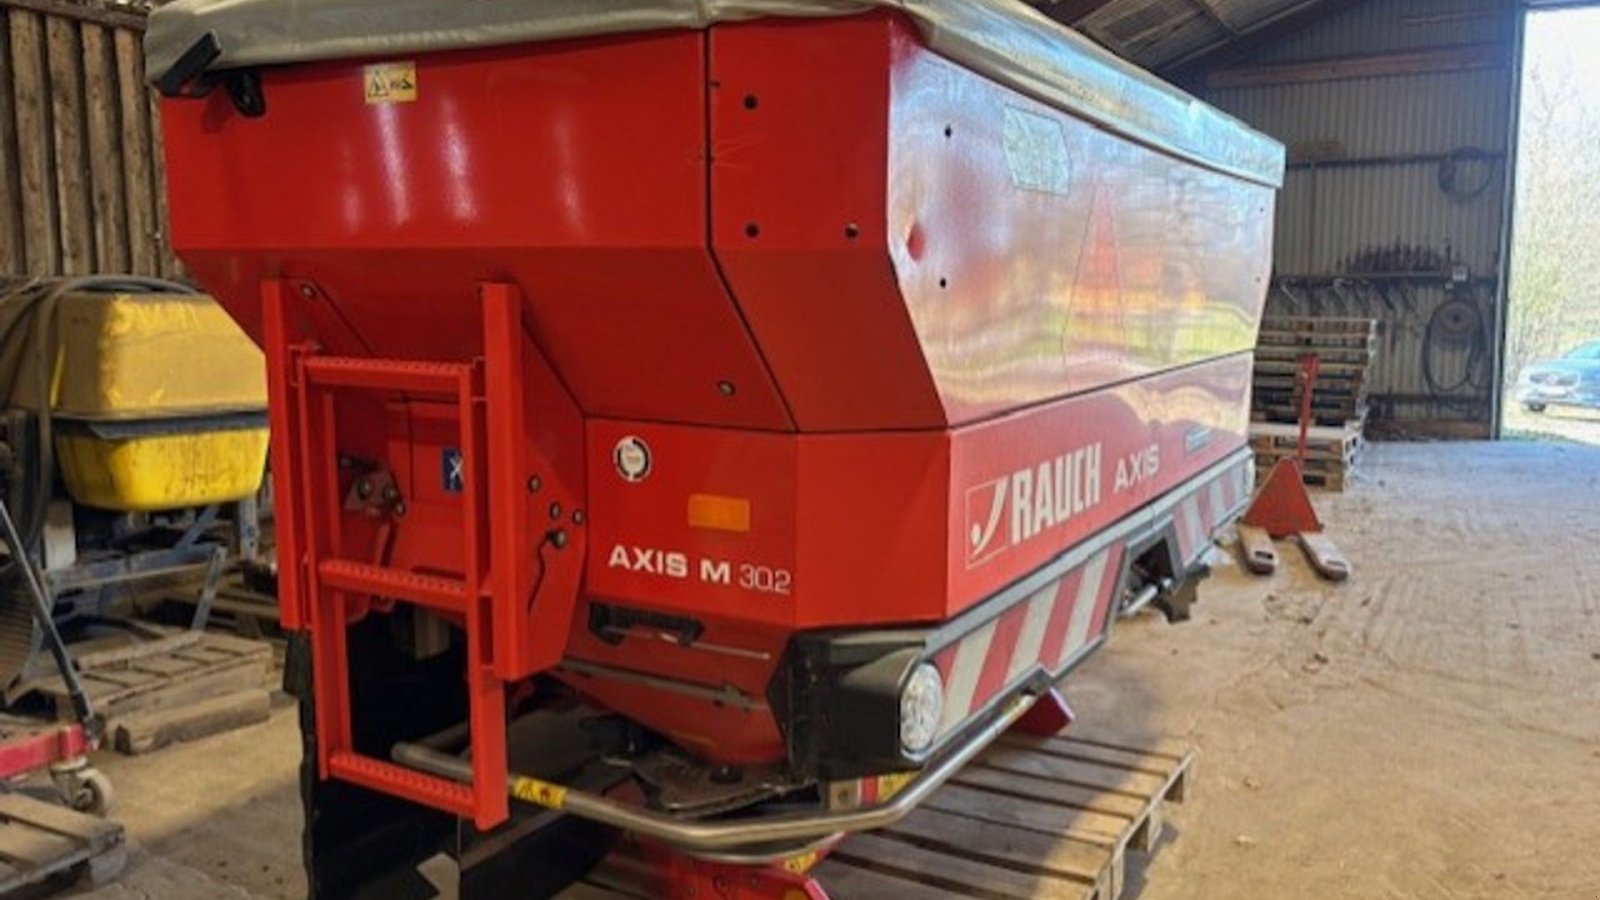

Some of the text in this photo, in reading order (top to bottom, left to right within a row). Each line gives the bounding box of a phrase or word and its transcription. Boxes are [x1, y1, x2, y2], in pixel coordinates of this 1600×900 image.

[1010, 441, 1159, 546] RAUCH AXIS
[608, 544, 689, 578] AXIS
[700, 558, 731, 585] M
